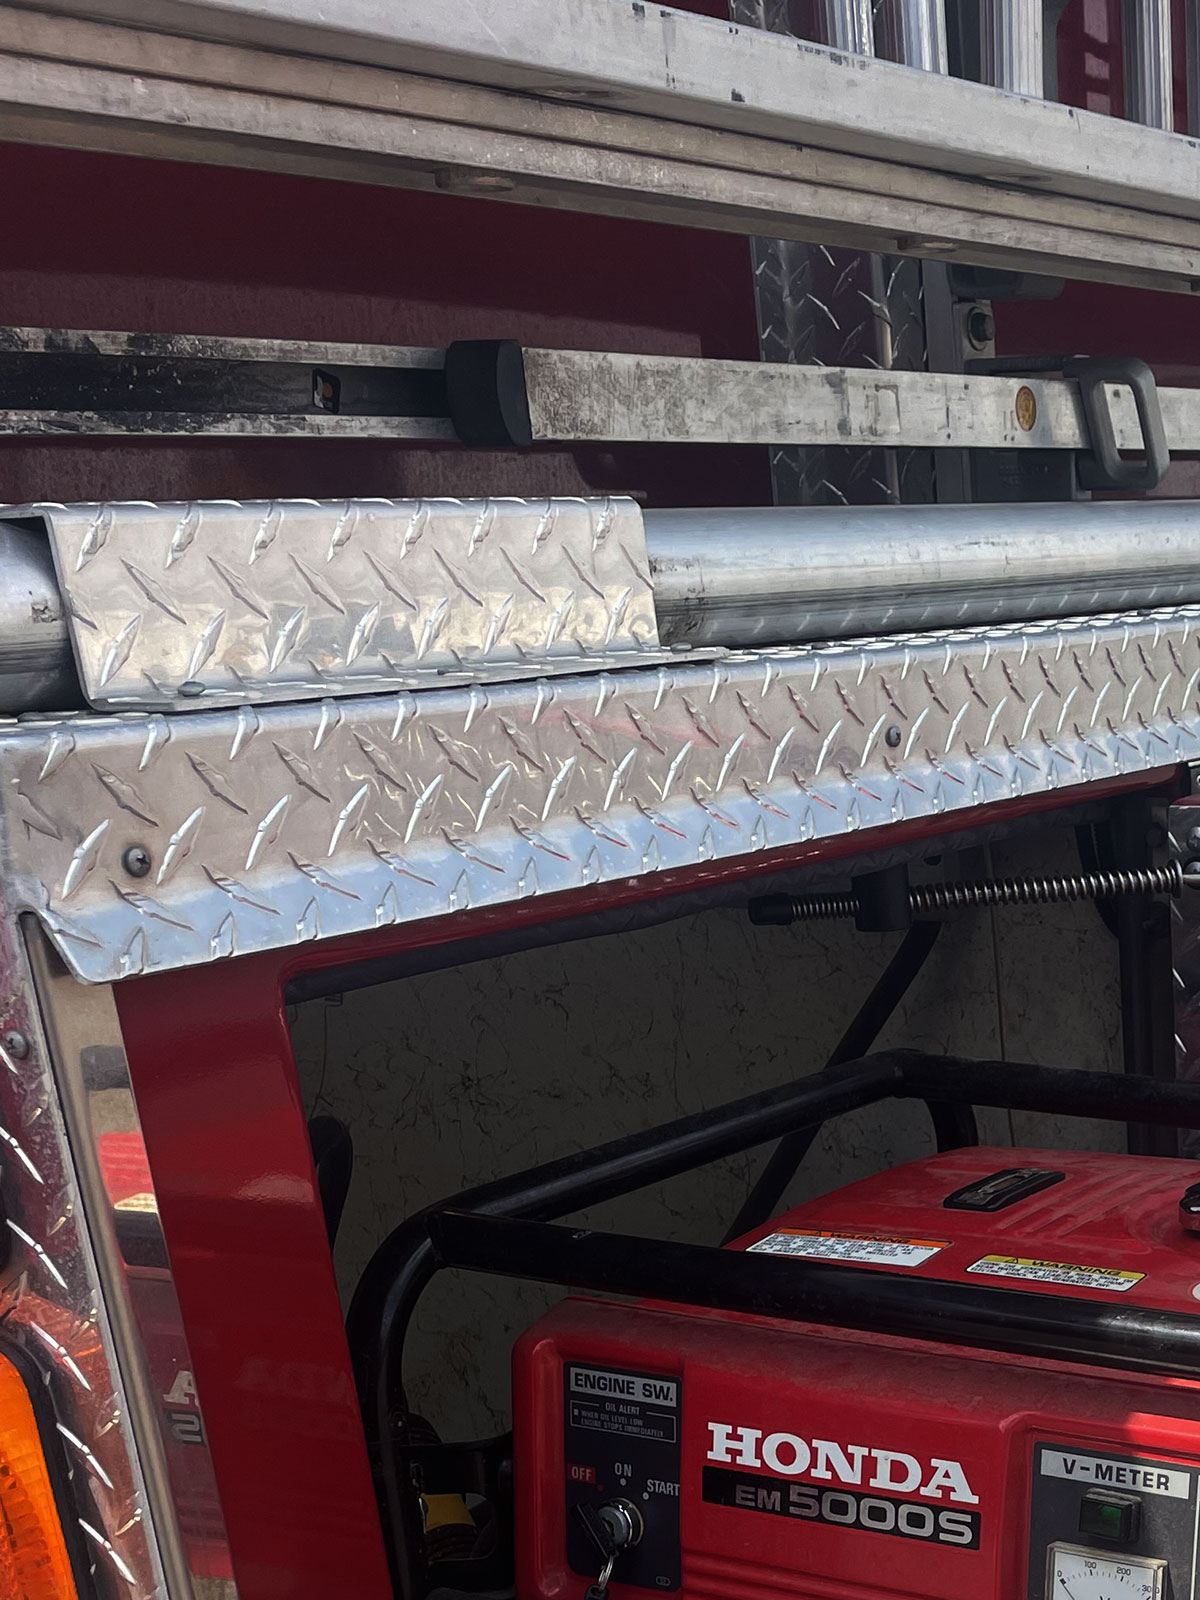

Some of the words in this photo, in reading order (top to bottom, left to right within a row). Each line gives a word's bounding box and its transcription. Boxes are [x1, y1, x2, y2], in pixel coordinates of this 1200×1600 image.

[830, 1232, 912, 1245] WARNING
[1031, 1259, 1122, 1276] WARNING
[574, 1372, 635, 1396] ENGINE
[642, 1383, 673, 1402] SW.
[605, 1402, 617, 1412] OIL
[619, 1404, 640, 1415] ALERT
[614, 1462, 632, 1478] ON
[706, 1422, 979, 1504] HONDA
[571, 1466, 592, 1481] OFF
[1062, 1457, 1170, 1491] V-METER
[646, 1478, 680, 1497] START
[1084, 1560, 1097, 1569] 100
[1116, 1566, 1131, 1576] 200
[1057, 1569, 1063, 1578] 0
